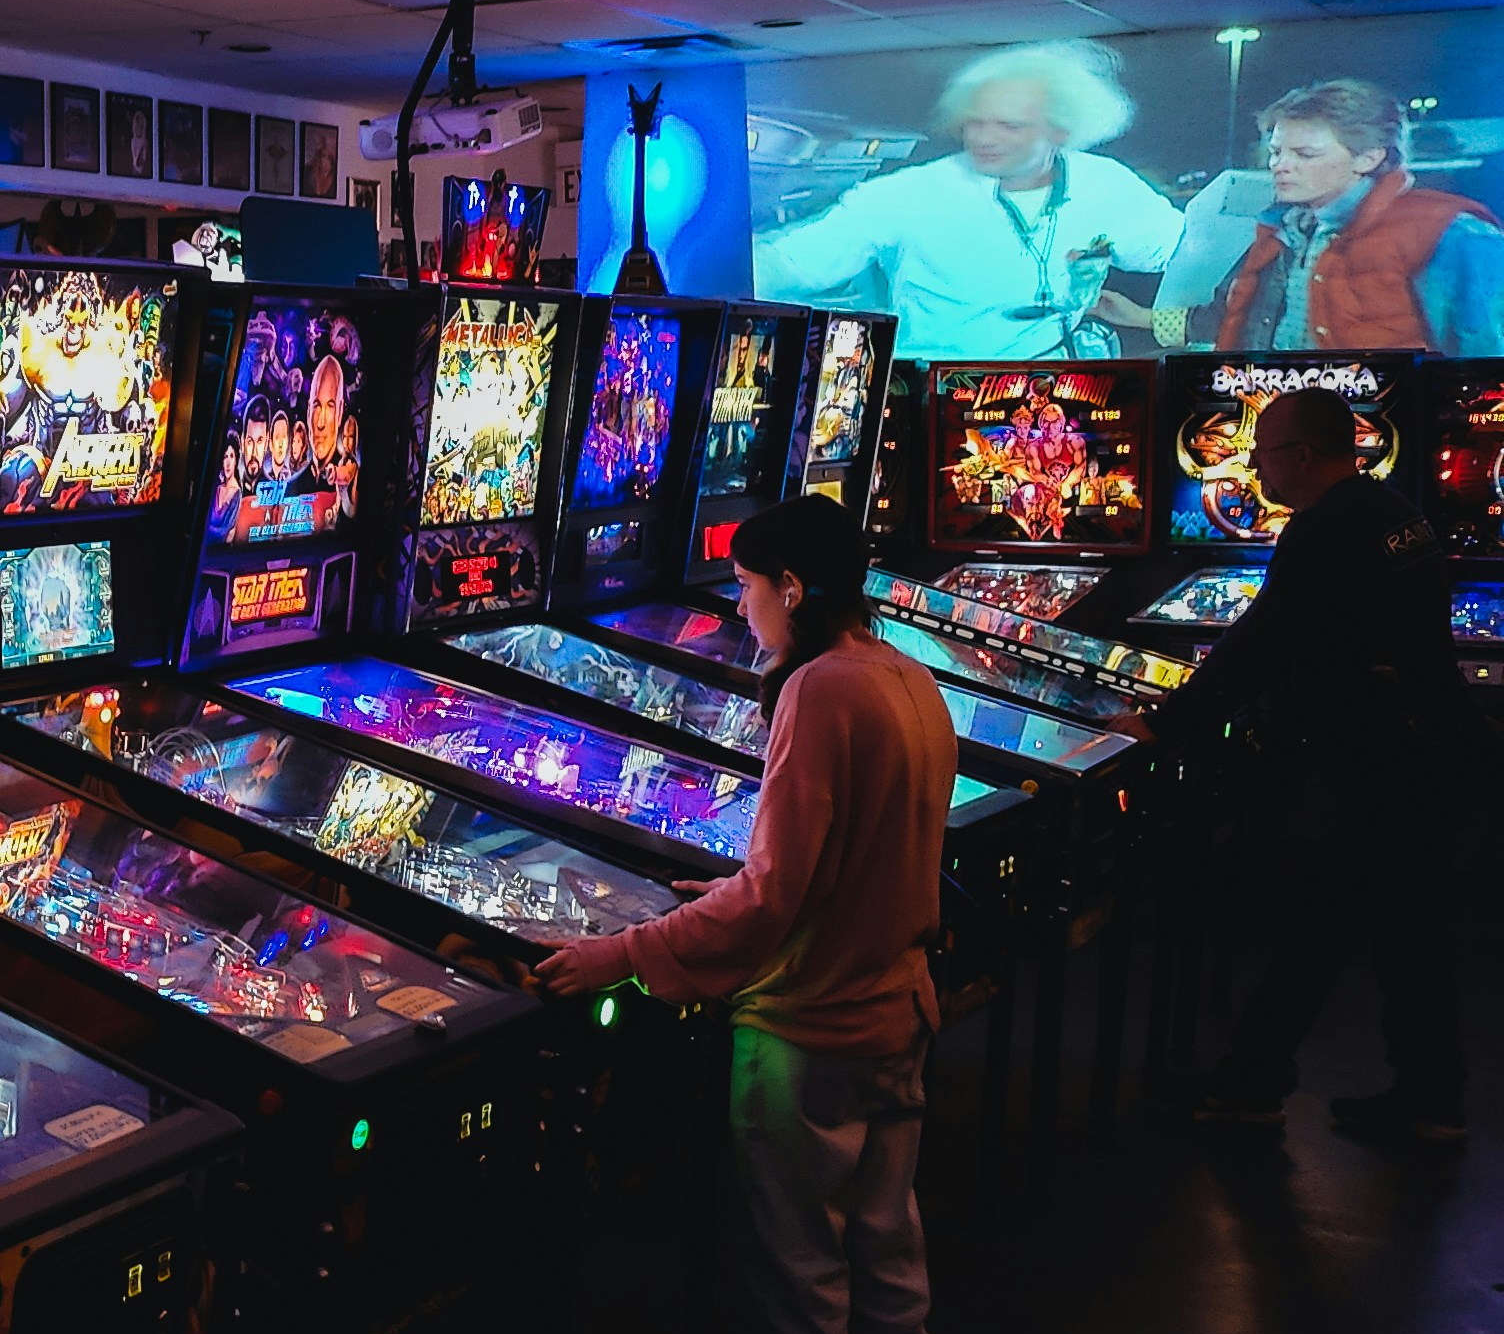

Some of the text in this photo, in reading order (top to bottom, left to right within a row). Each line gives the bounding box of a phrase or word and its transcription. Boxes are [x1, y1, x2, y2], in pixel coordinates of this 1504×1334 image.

[441, 306, 538, 348] METALLICA
[973, 374, 1028, 410] FLASH
[1212, 367, 1378, 398] BARRACORA
